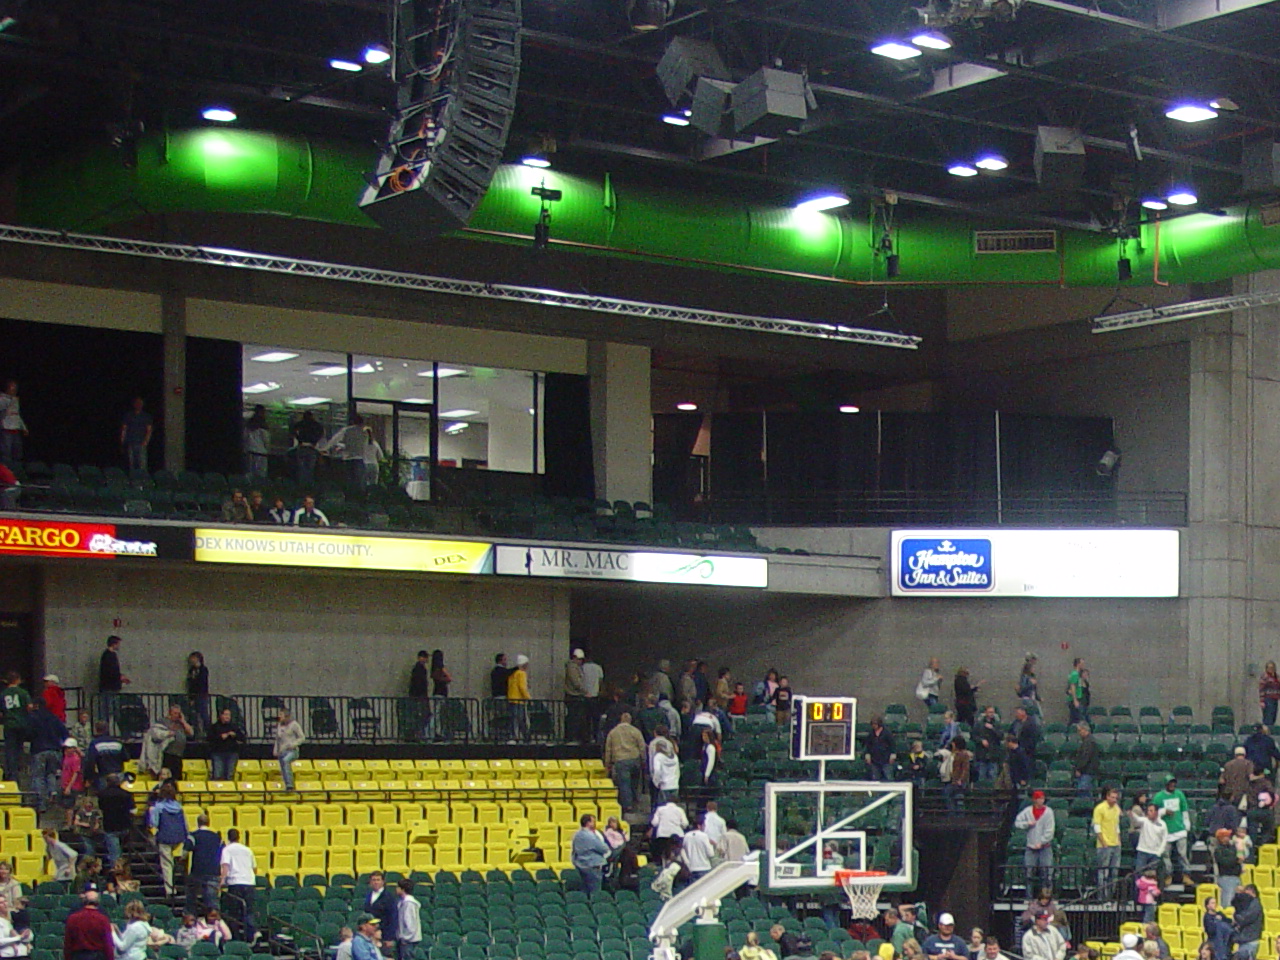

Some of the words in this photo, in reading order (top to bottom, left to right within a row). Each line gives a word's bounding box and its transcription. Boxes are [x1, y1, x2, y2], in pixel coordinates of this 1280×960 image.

[195, 537, 222, 550] DEX
[225, 538, 276, 552] KNOWS
[279, 541, 315, 554] UTAH
[541, 549, 578, 568] MR.
[584, 552, 629, 570] MAC
[908, 549, 985, 570] Hampton
